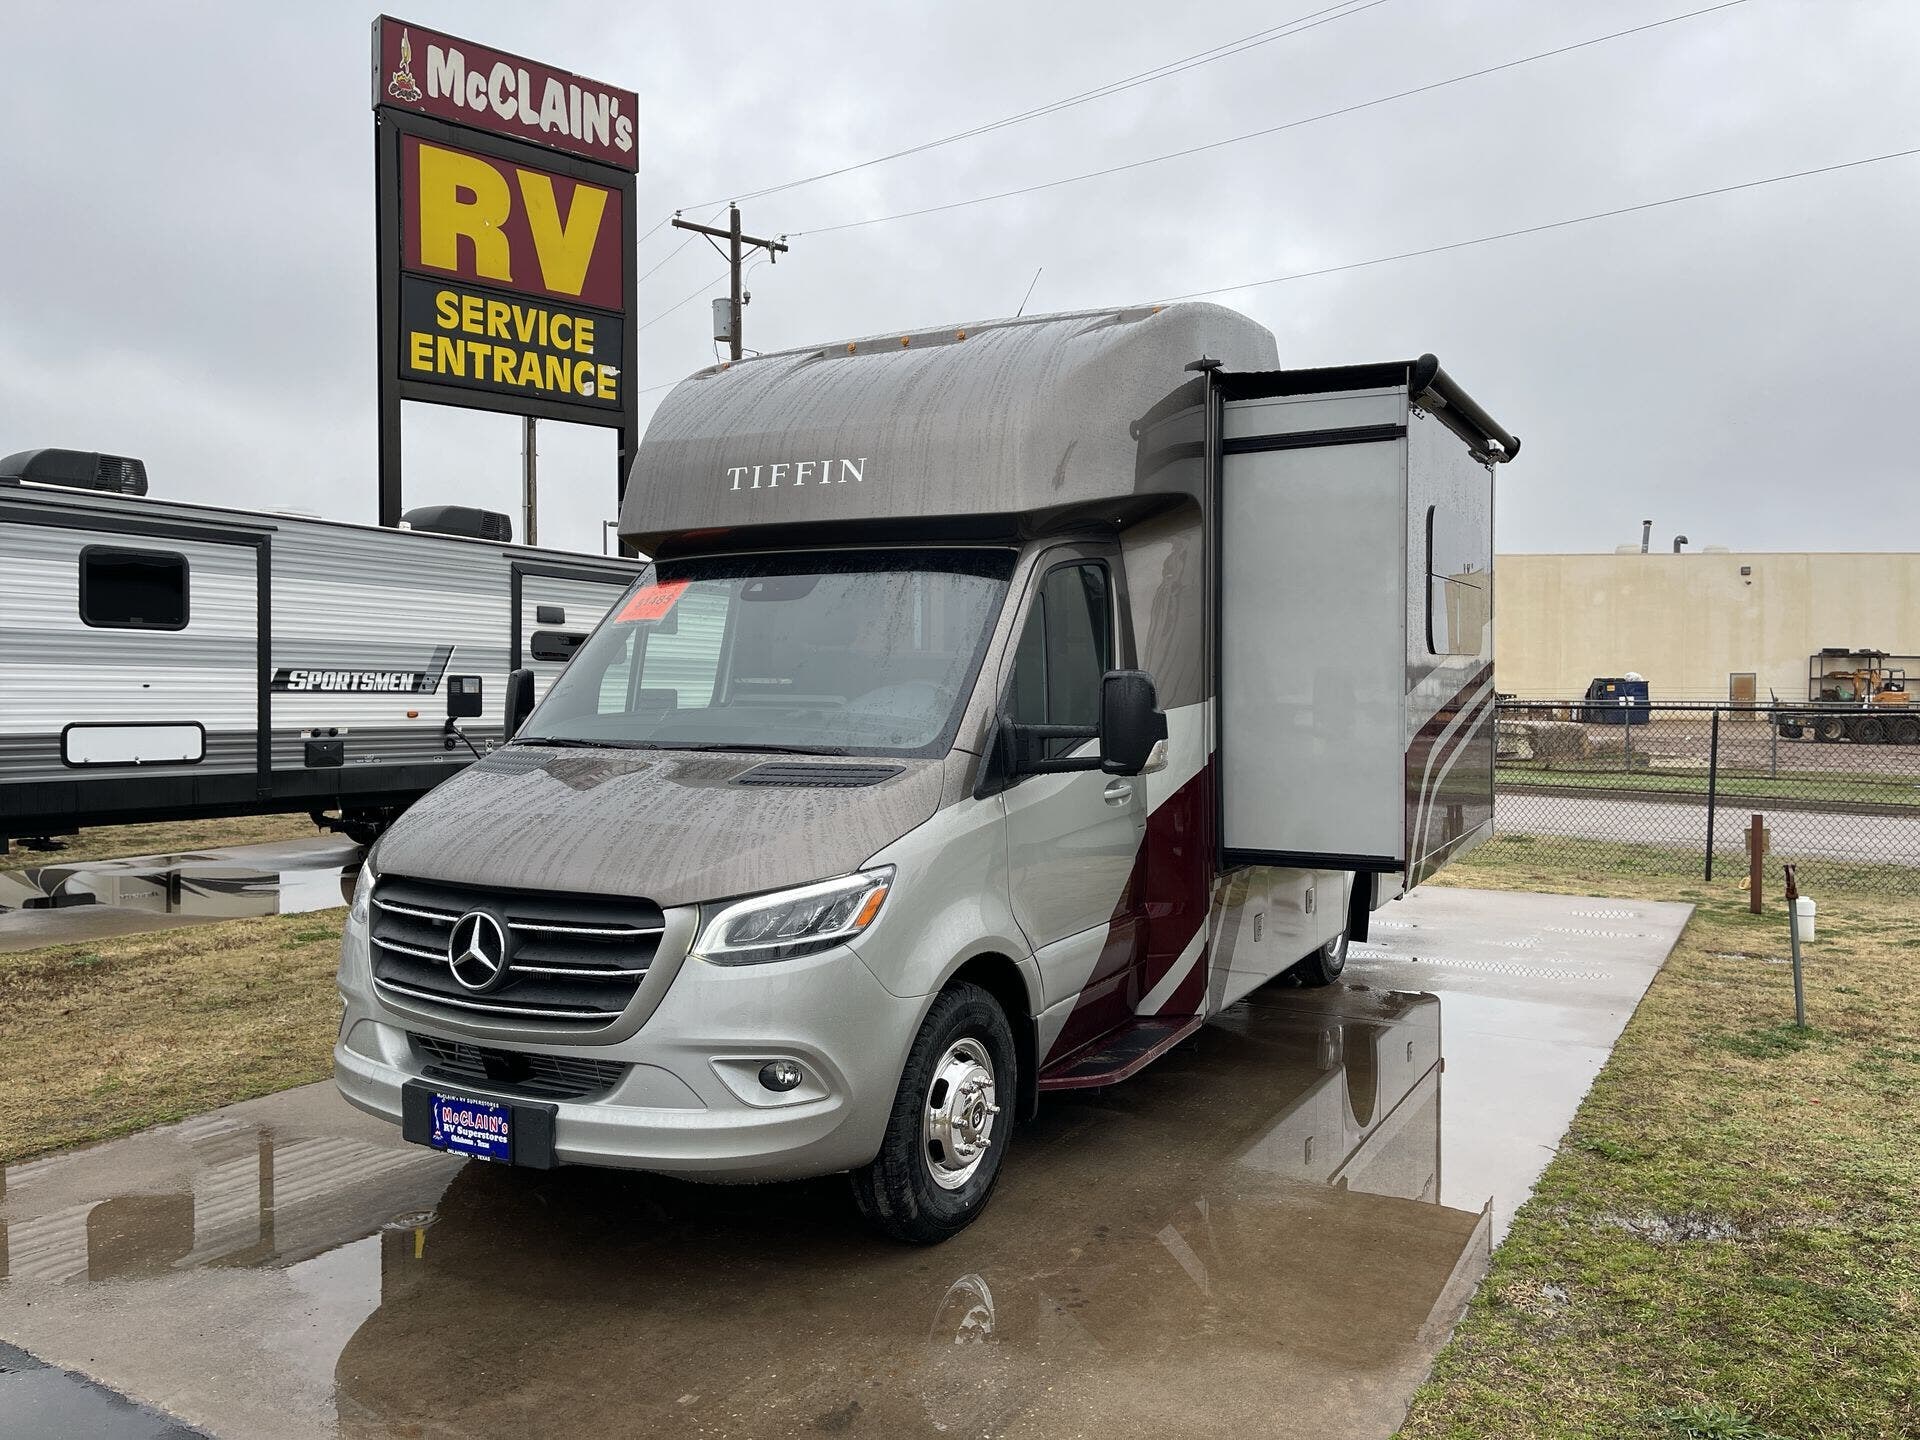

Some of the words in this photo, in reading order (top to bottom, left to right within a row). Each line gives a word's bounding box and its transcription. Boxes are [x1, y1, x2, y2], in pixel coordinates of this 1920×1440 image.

[426, 44, 632, 153] McCLAIN's
[418, 143, 609, 297] RV
[435, 290, 595, 355] SERVICE
[410, 331, 618, 401] ENTRANCE
[727, 457, 867, 491] TIFFIN
[287, 670, 415, 692] SPORTSMEN
[443, 1124, 455, 1132] RV
[457, 1126, 507, 1143] Superstores
